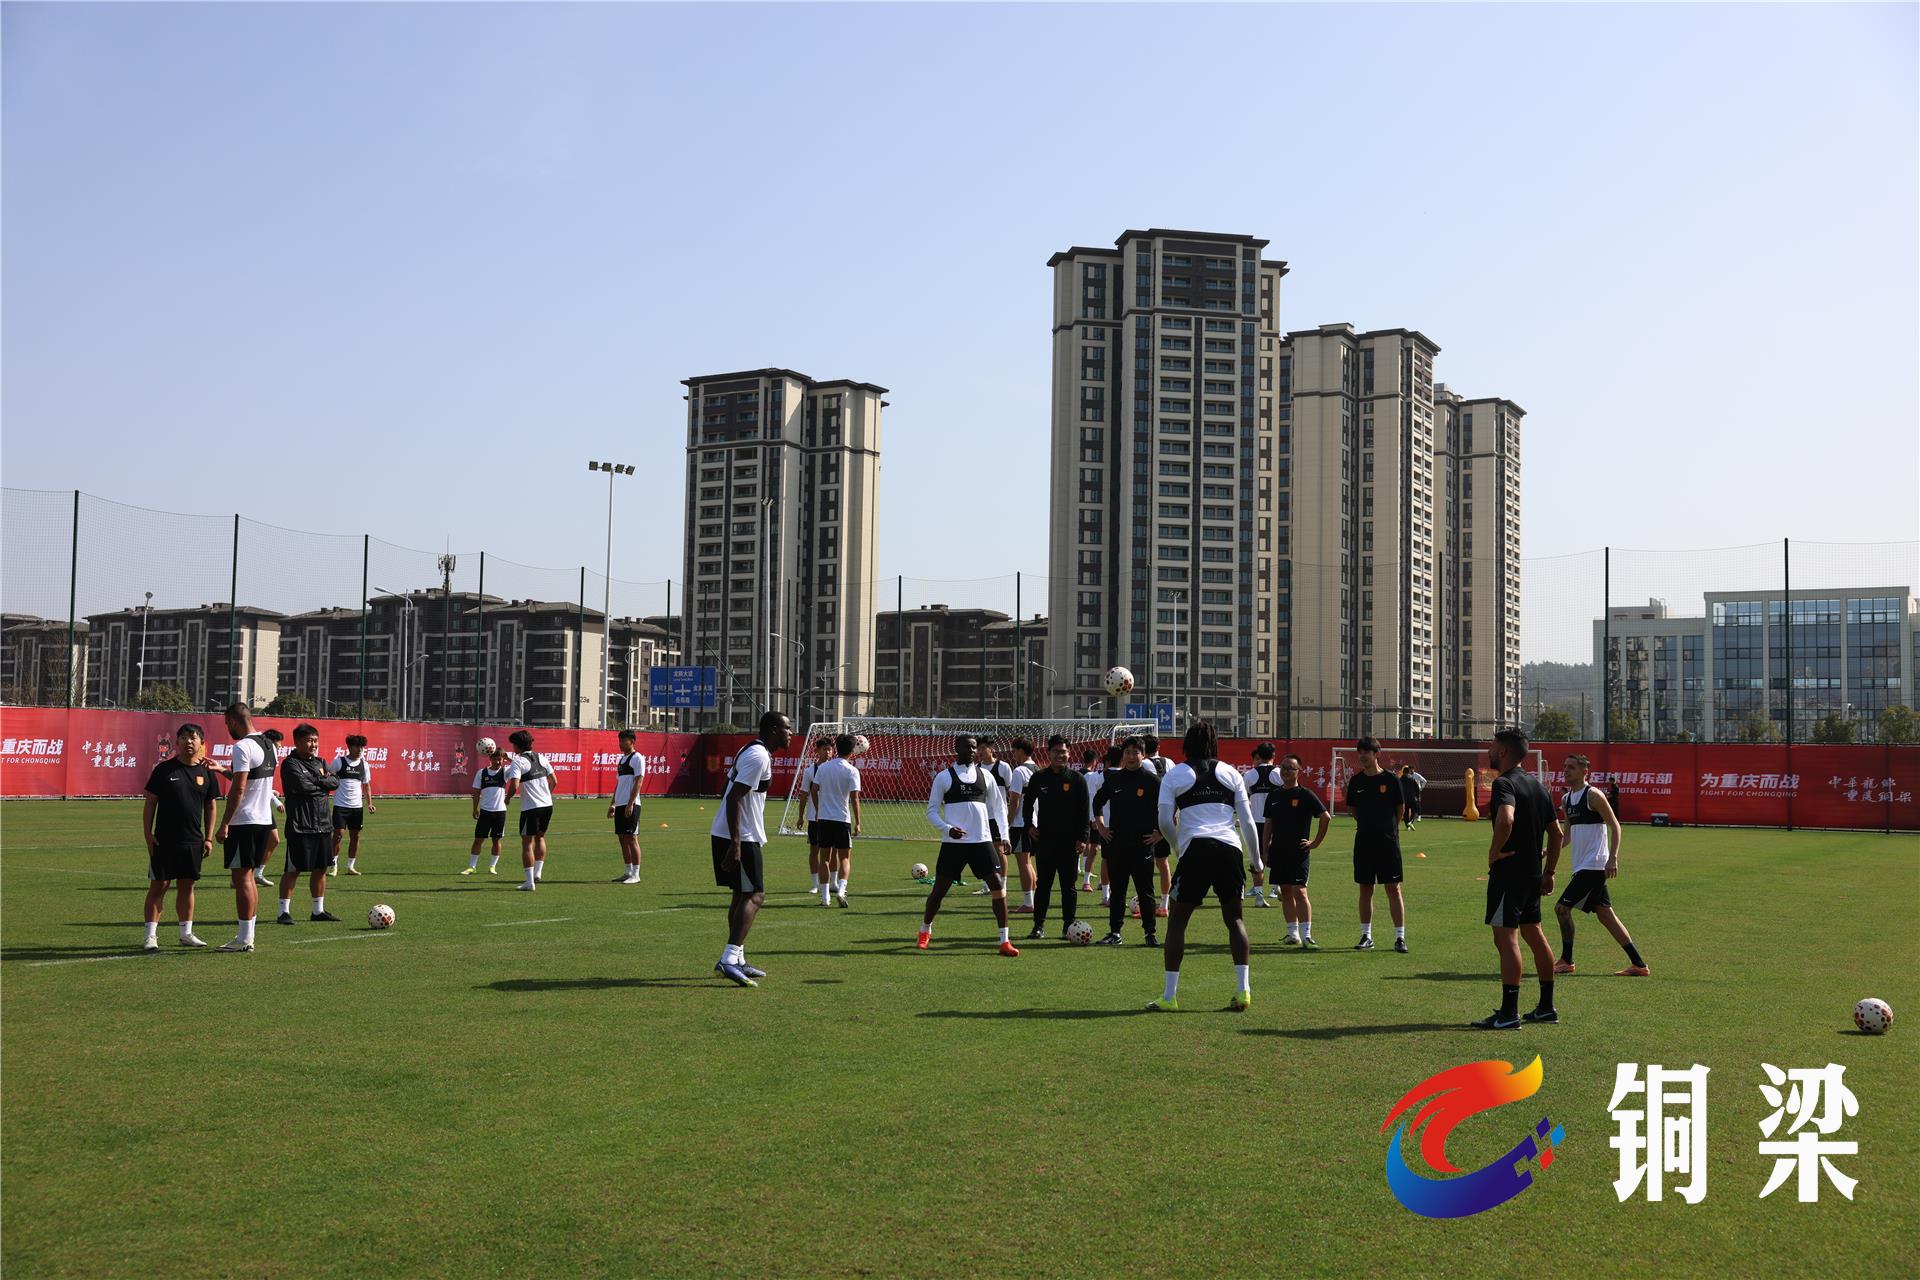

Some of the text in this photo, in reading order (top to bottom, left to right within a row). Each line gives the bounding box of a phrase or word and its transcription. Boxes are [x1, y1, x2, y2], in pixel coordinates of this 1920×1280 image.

[0, 738, 63, 755] 重庆而战
[854, 758, 902, 769] 重庆而战
[1700, 773, 1799, 789] 为重庆而战
